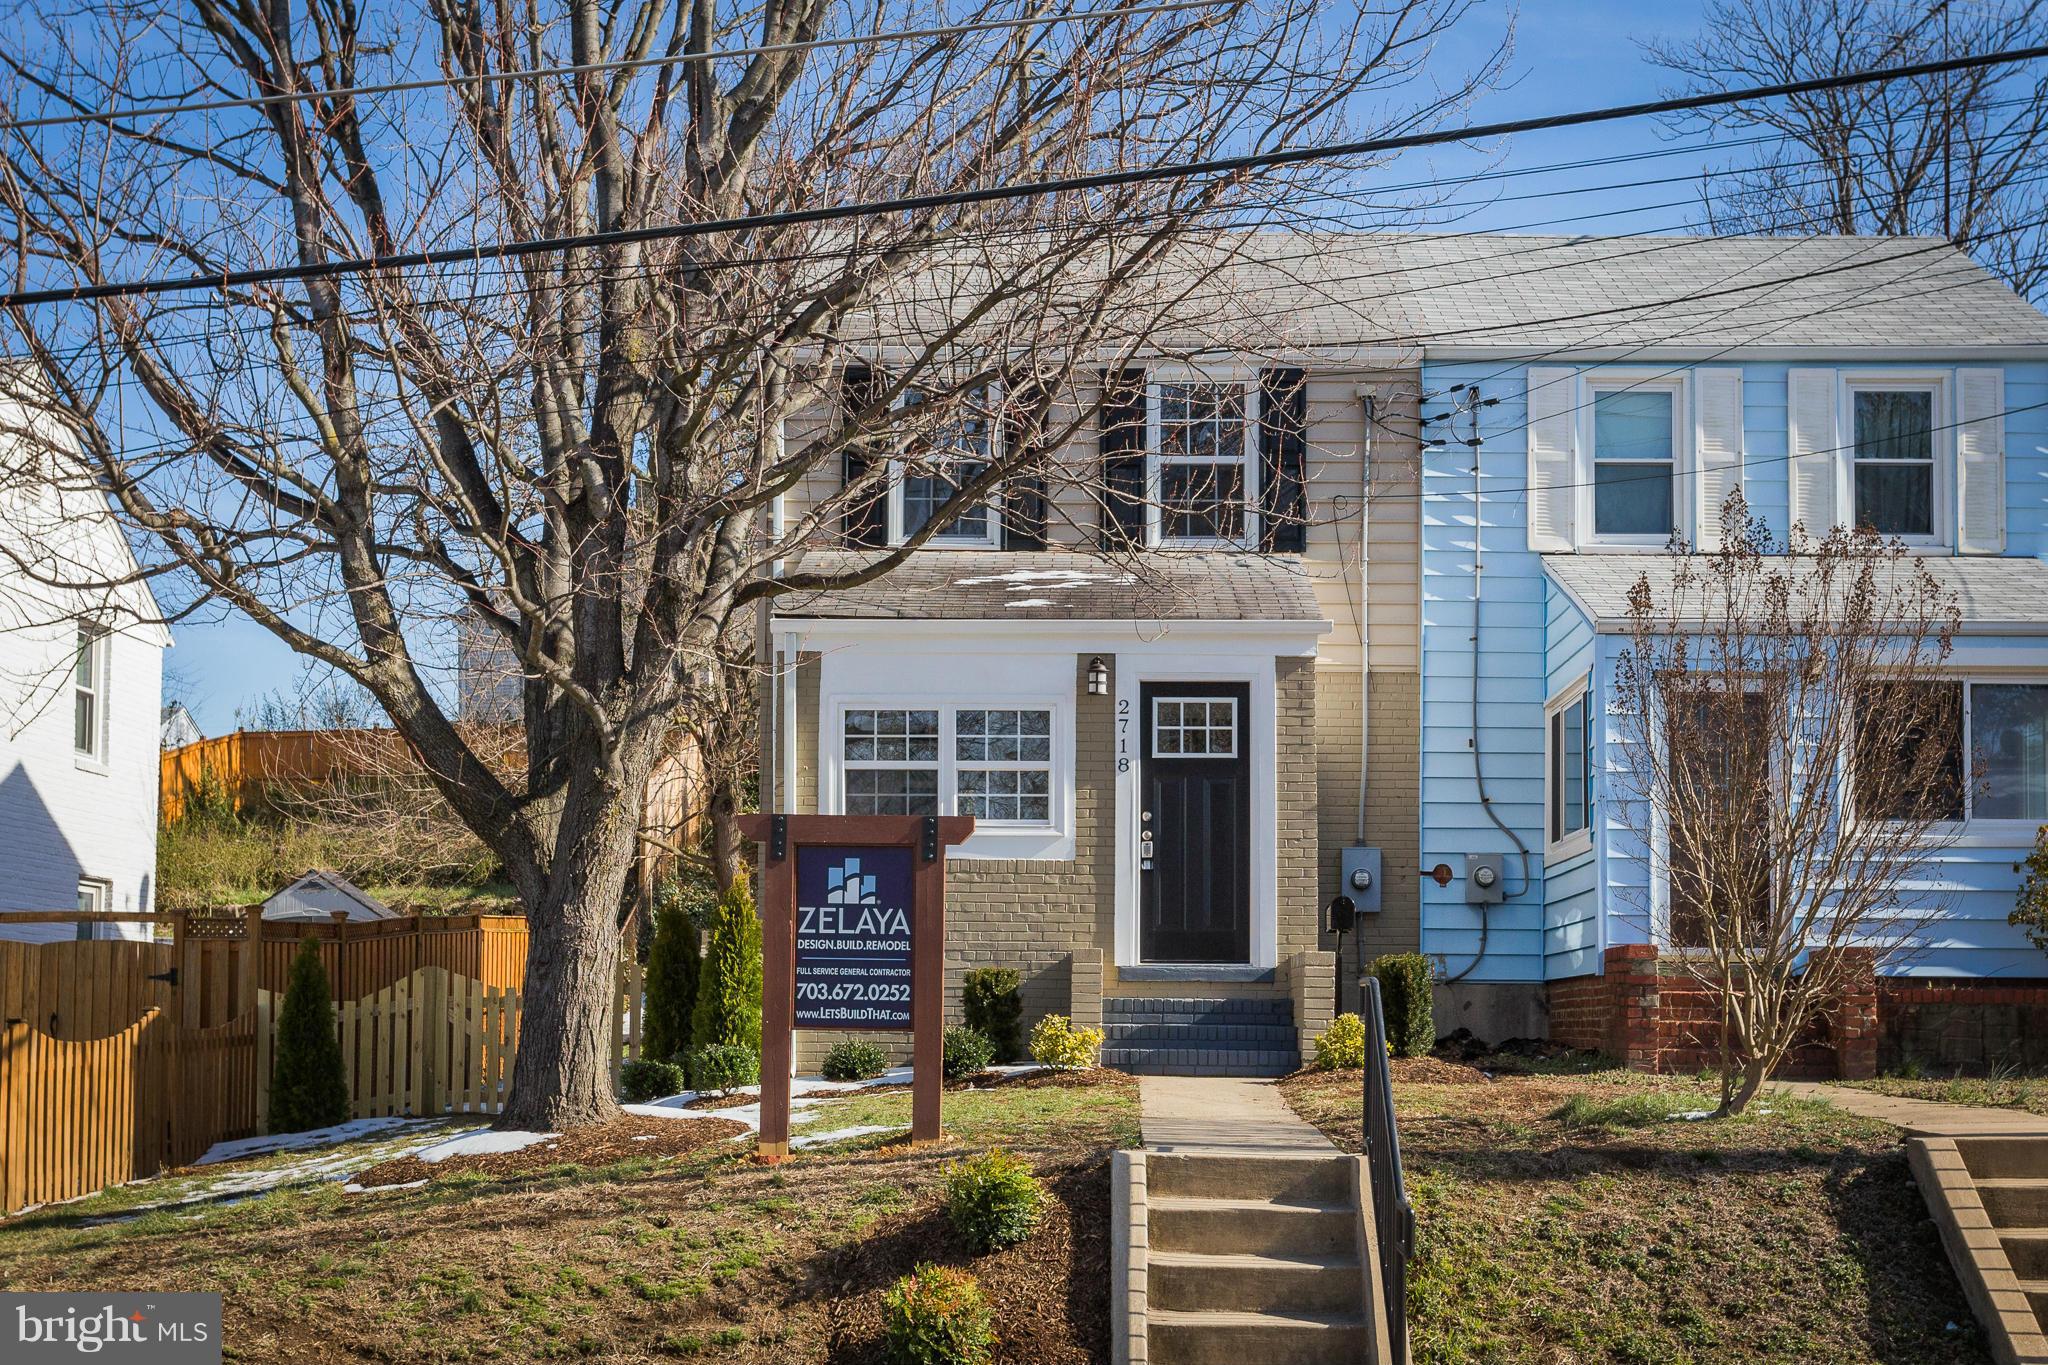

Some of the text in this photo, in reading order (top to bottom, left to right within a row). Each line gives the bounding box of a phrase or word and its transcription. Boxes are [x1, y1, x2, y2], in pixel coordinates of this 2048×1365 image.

[1118, 699, 1129, 773] 2718
[798, 907, 911, 935] ZELAYA
[797, 939, 911, 951] DESIGN.BUILD.REMODEL
[796, 967, 911, 976] FULL SERVICE GENERAL CONTRACTOR
[796, 983, 911, 1001] 703.672.0252
